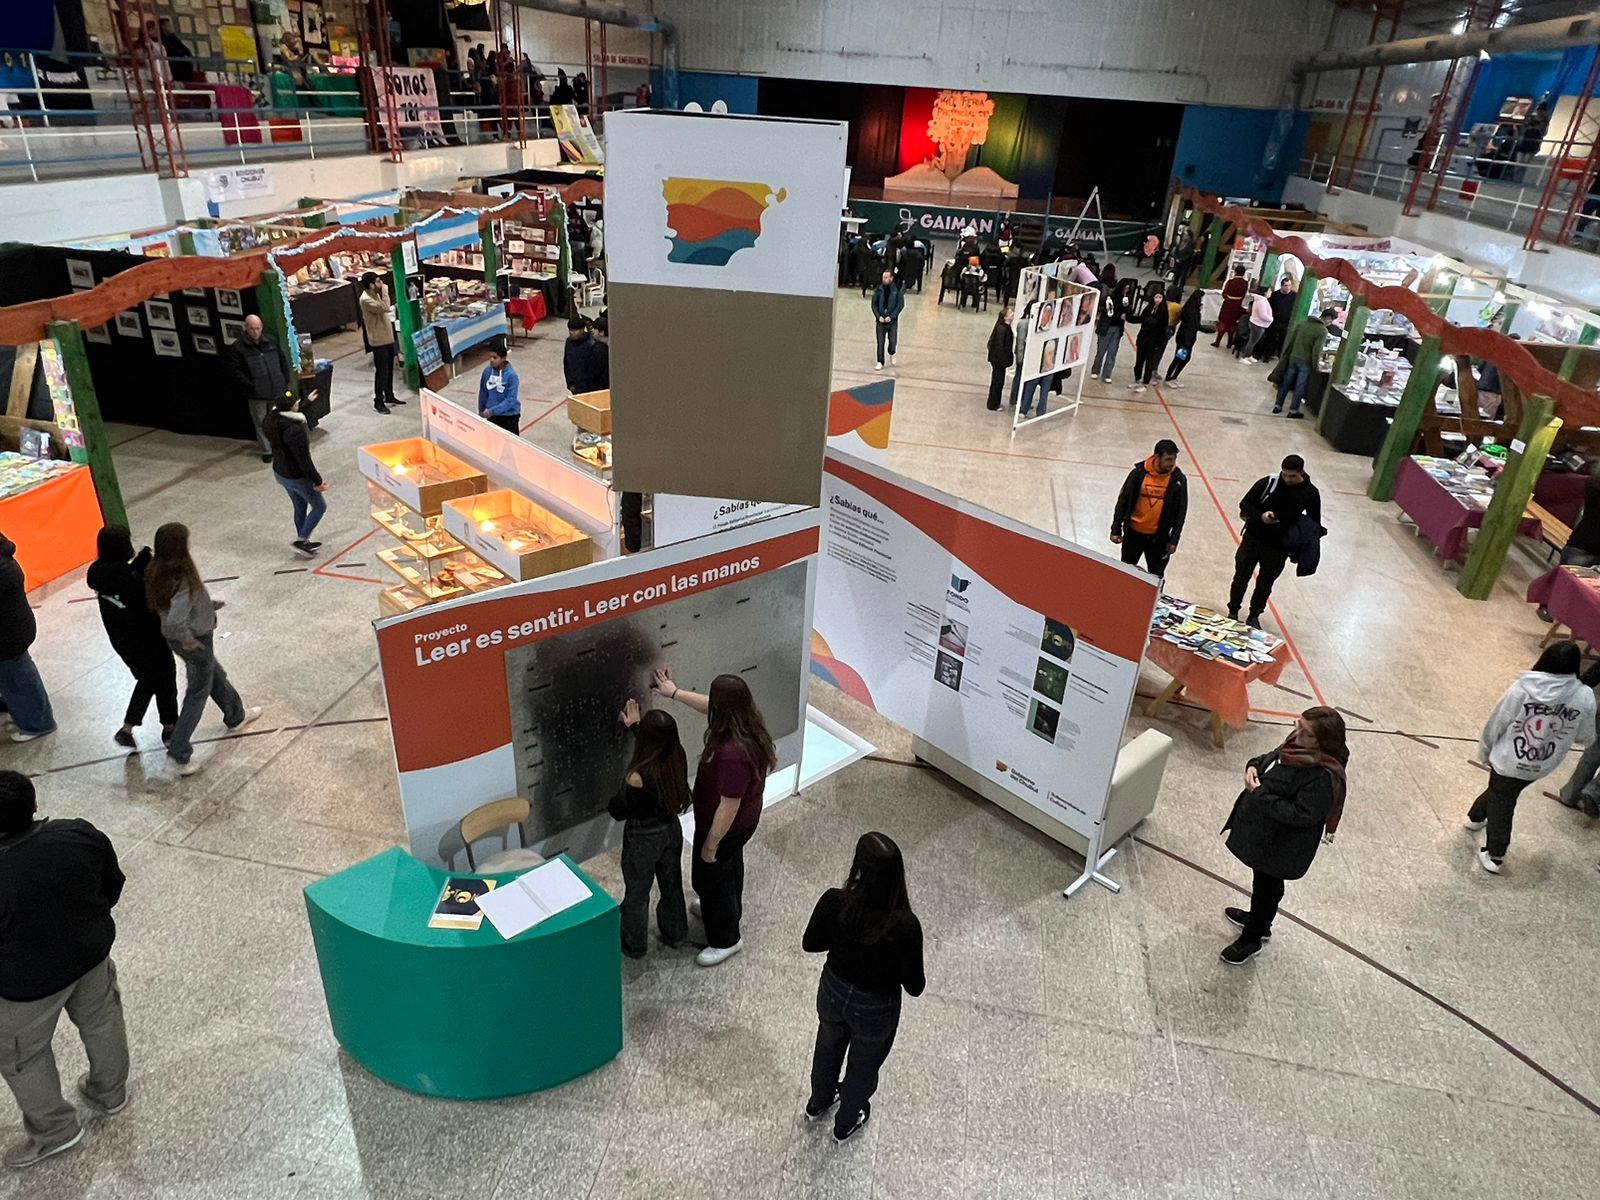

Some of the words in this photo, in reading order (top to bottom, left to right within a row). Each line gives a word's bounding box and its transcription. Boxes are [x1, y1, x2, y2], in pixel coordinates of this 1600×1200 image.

[385, 72, 428, 96] SOMOS
[920, 213, 993, 233] GAIMAN
[1054, 227, 1105, 242] GAIMAN
[415, 637, 471, 667] Leer
[475, 629, 503, 649] es
[507, 607, 579, 640] sentir.
[584, 593, 629, 618] Leer
[633, 582, 666, 603] con
[671, 574, 699, 593] las
[702, 556, 760, 584] manos
[414, 623, 468, 644] Proyecto
[1513, 736, 1556, 761] GOOD
